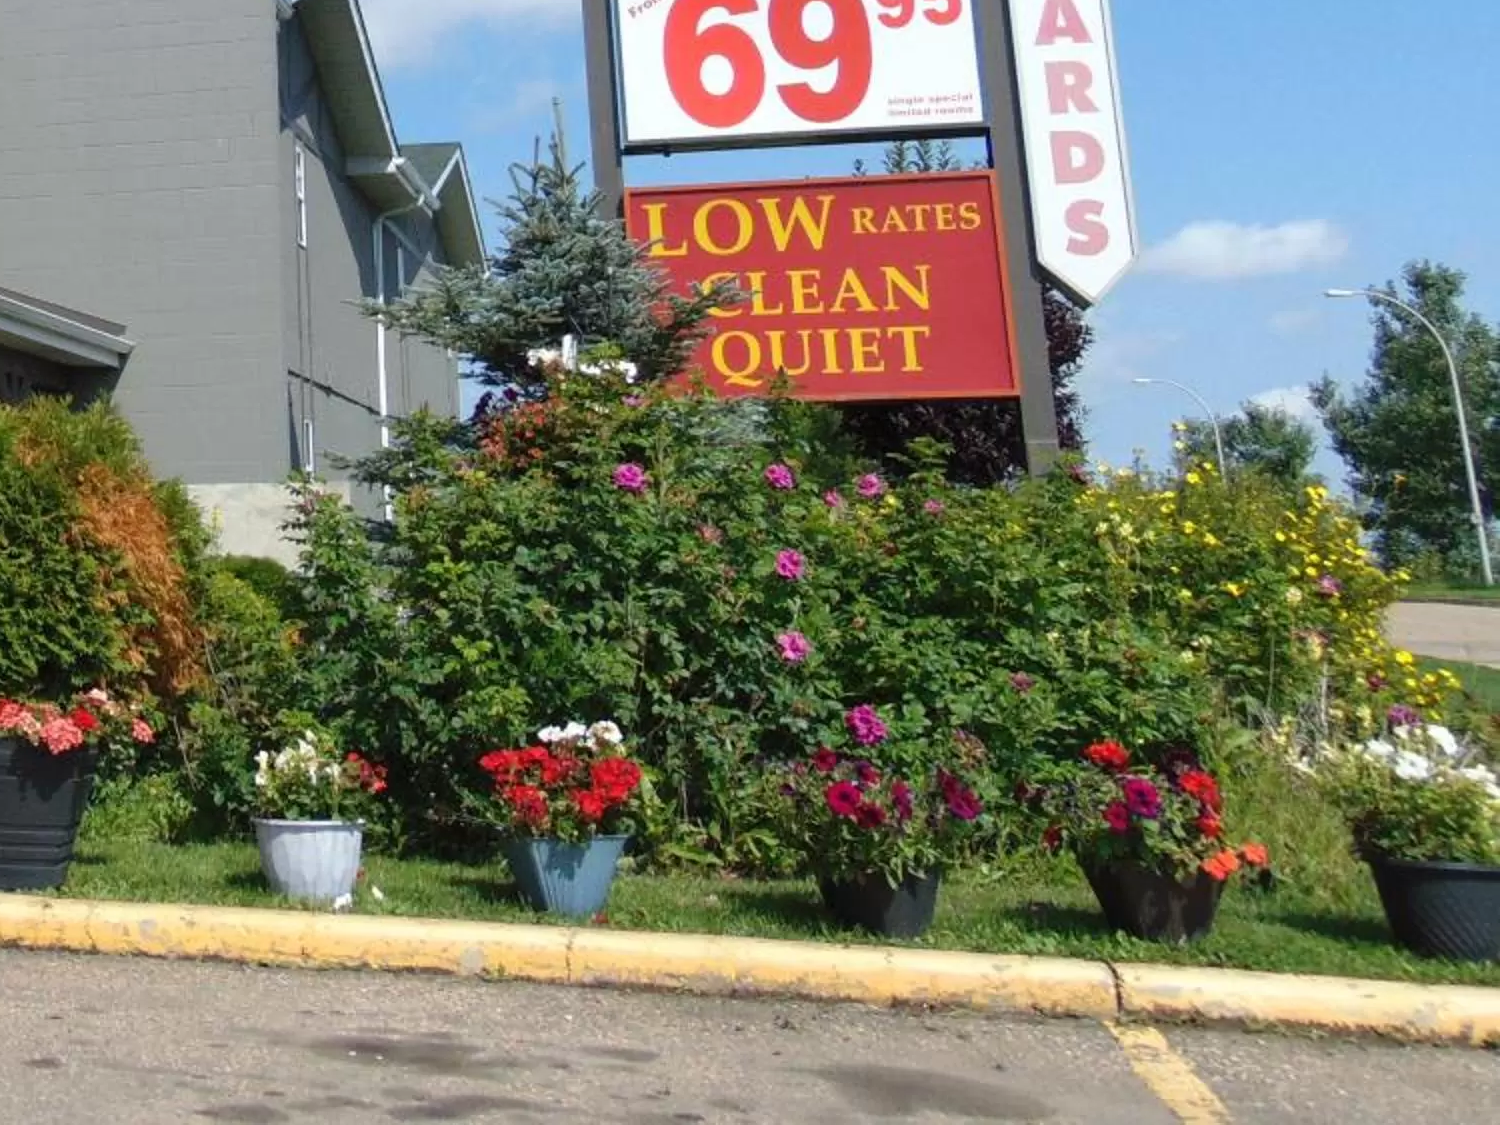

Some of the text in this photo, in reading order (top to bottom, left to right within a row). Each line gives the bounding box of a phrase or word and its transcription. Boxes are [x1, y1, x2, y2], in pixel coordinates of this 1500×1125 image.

[642, 195, 982, 257] LOW RATES
[701, 265, 931, 317] CLEAN
[711, 325, 930, 387] QUIET
